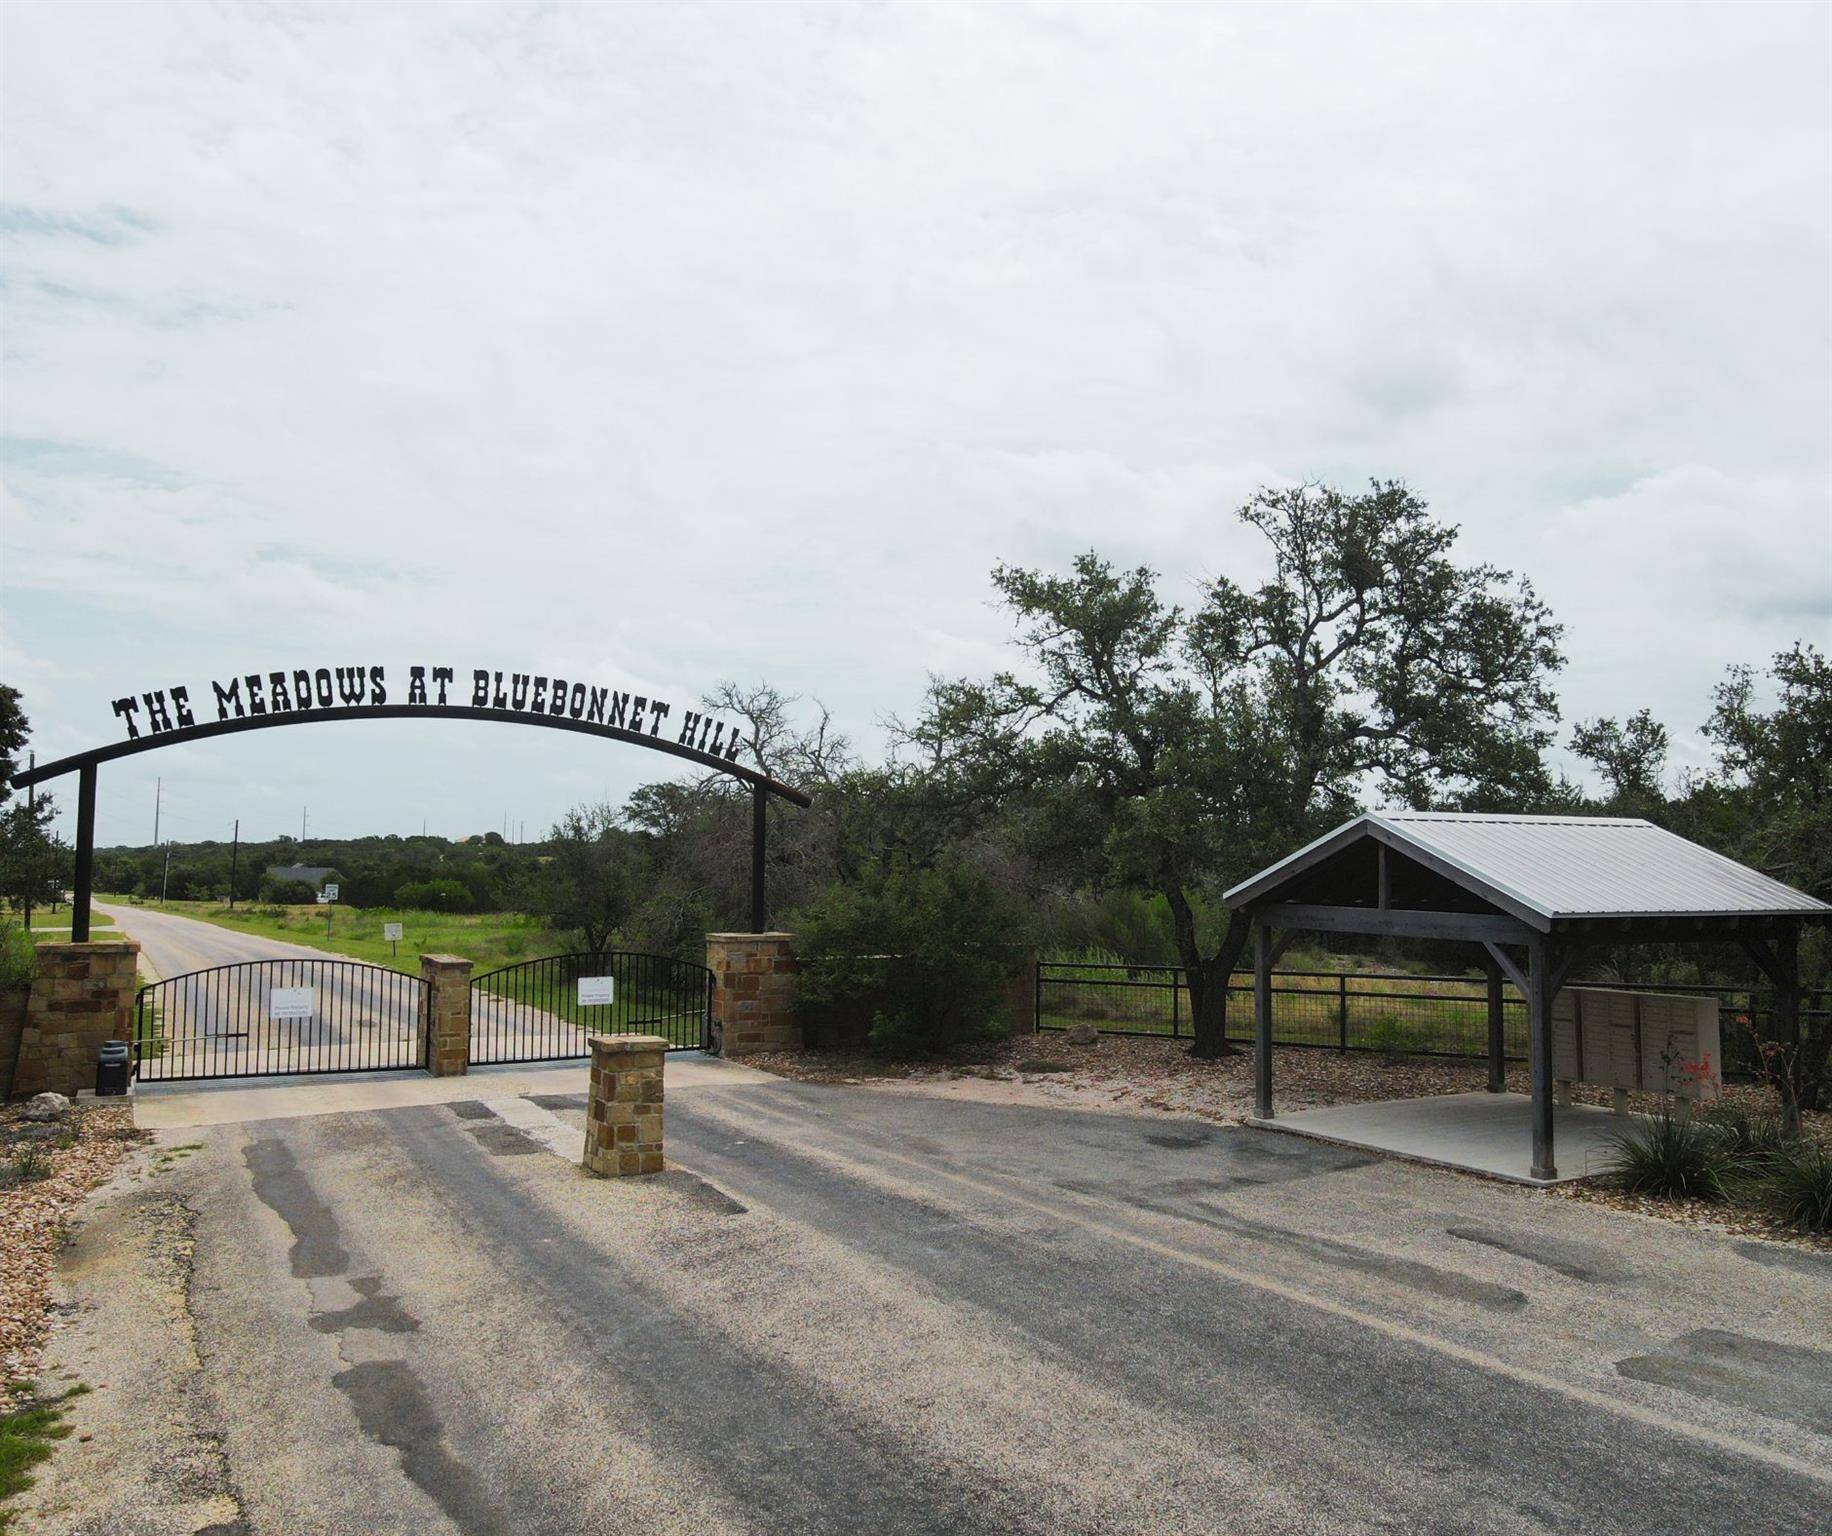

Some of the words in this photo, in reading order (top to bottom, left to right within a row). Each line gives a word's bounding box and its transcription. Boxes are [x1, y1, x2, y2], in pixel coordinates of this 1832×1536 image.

[112, 686, 194, 740] THE
[212, 666, 387, 721] MEADOWS
[408, 666, 453, 705] AT
[472, 670, 670, 737] BLUEBONNET
[678, 711, 740, 763] HILL
